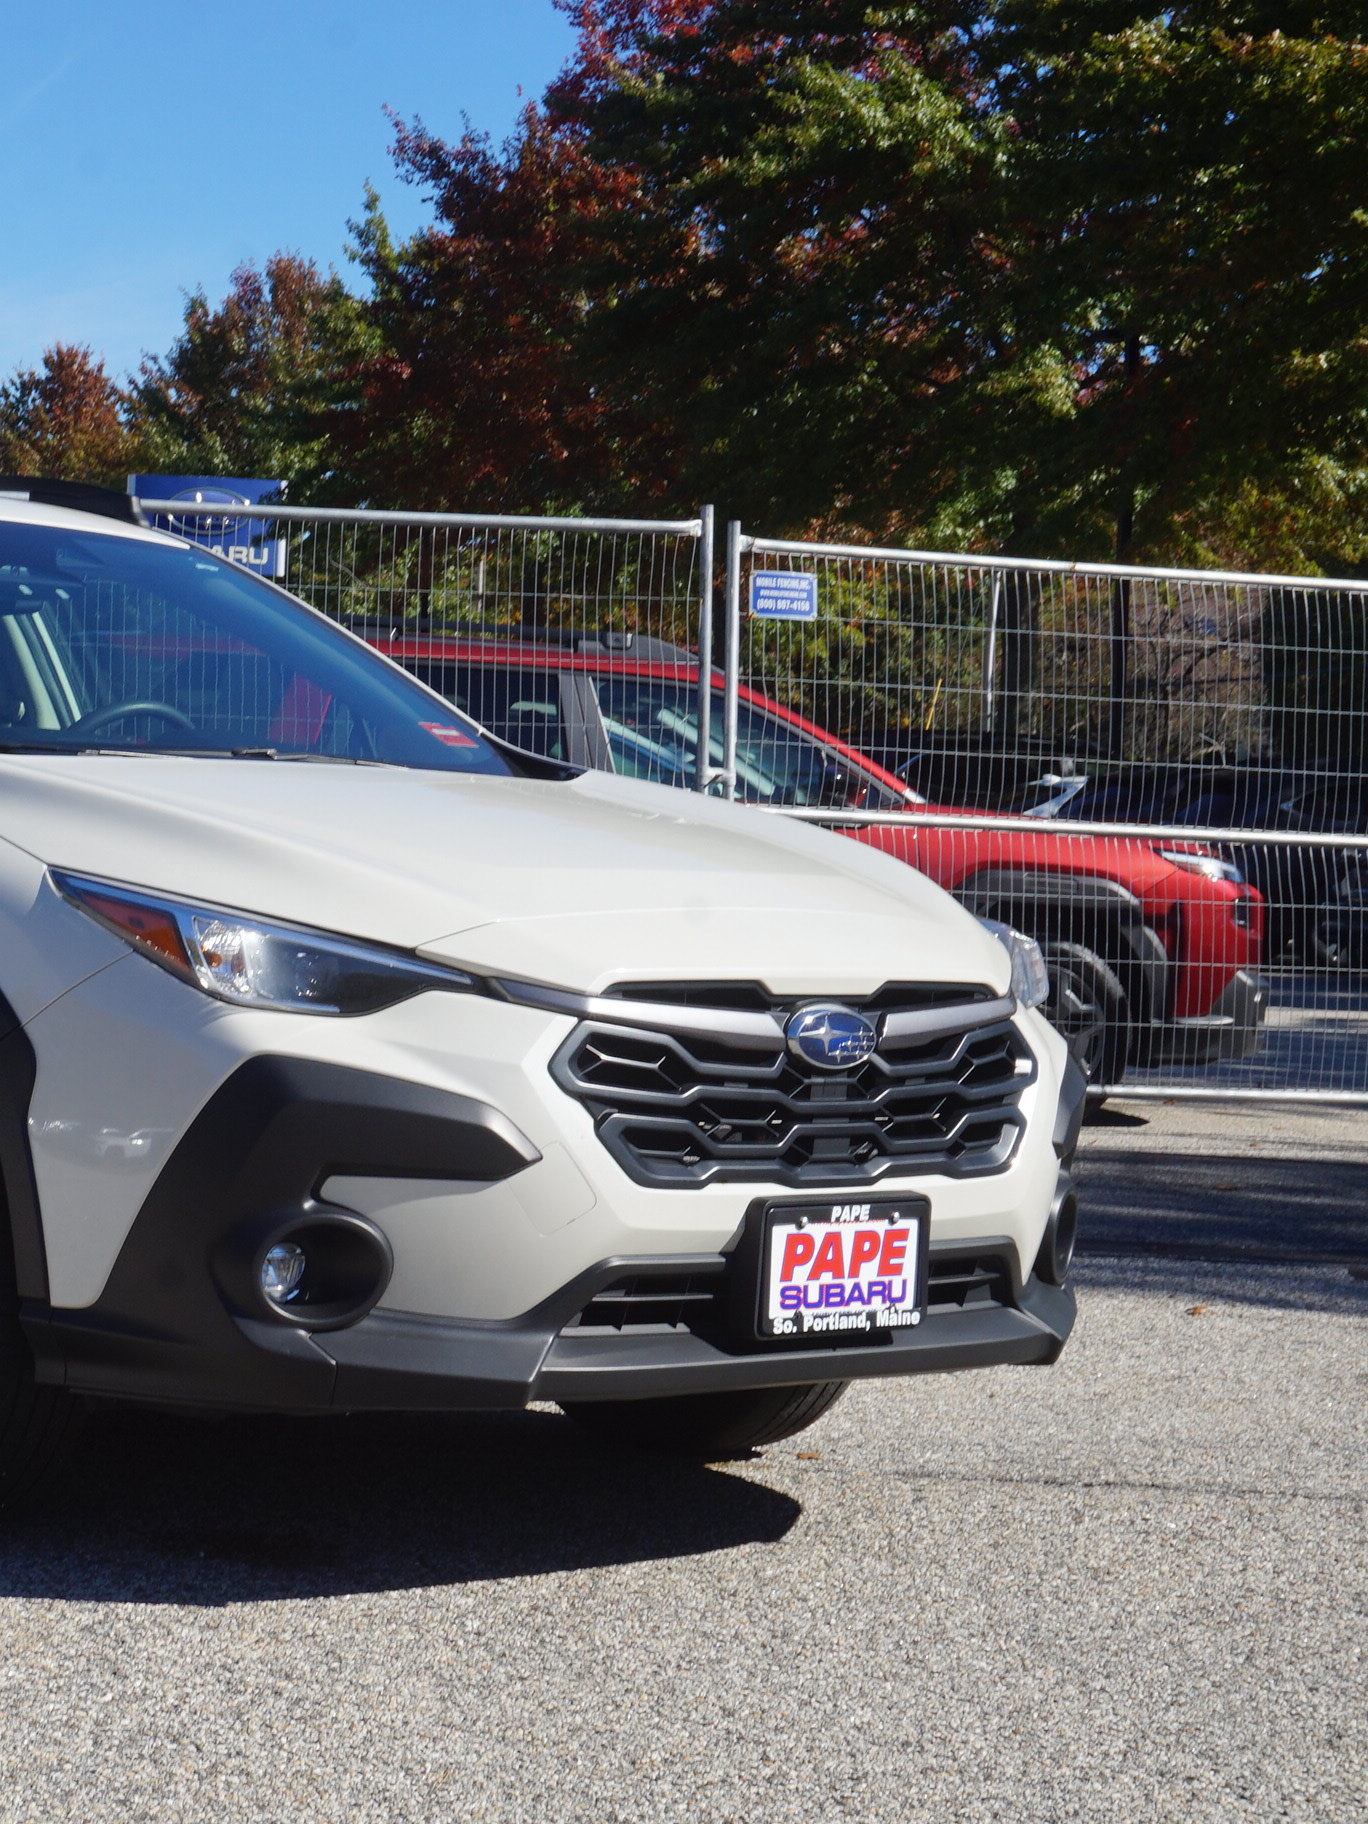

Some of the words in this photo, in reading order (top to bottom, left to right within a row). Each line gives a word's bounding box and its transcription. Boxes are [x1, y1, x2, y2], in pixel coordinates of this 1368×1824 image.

[211, 545, 269, 564] ARU
[831, 1204, 871, 1222] PAPE
[779, 1229, 910, 1282] PAPE
[779, 1279, 907, 1310] SUBARU
[773, 1317, 798, 1335] So.
[803, 1311, 870, 1332] Portland,
[876, 1307, 921, 1328] Maine
